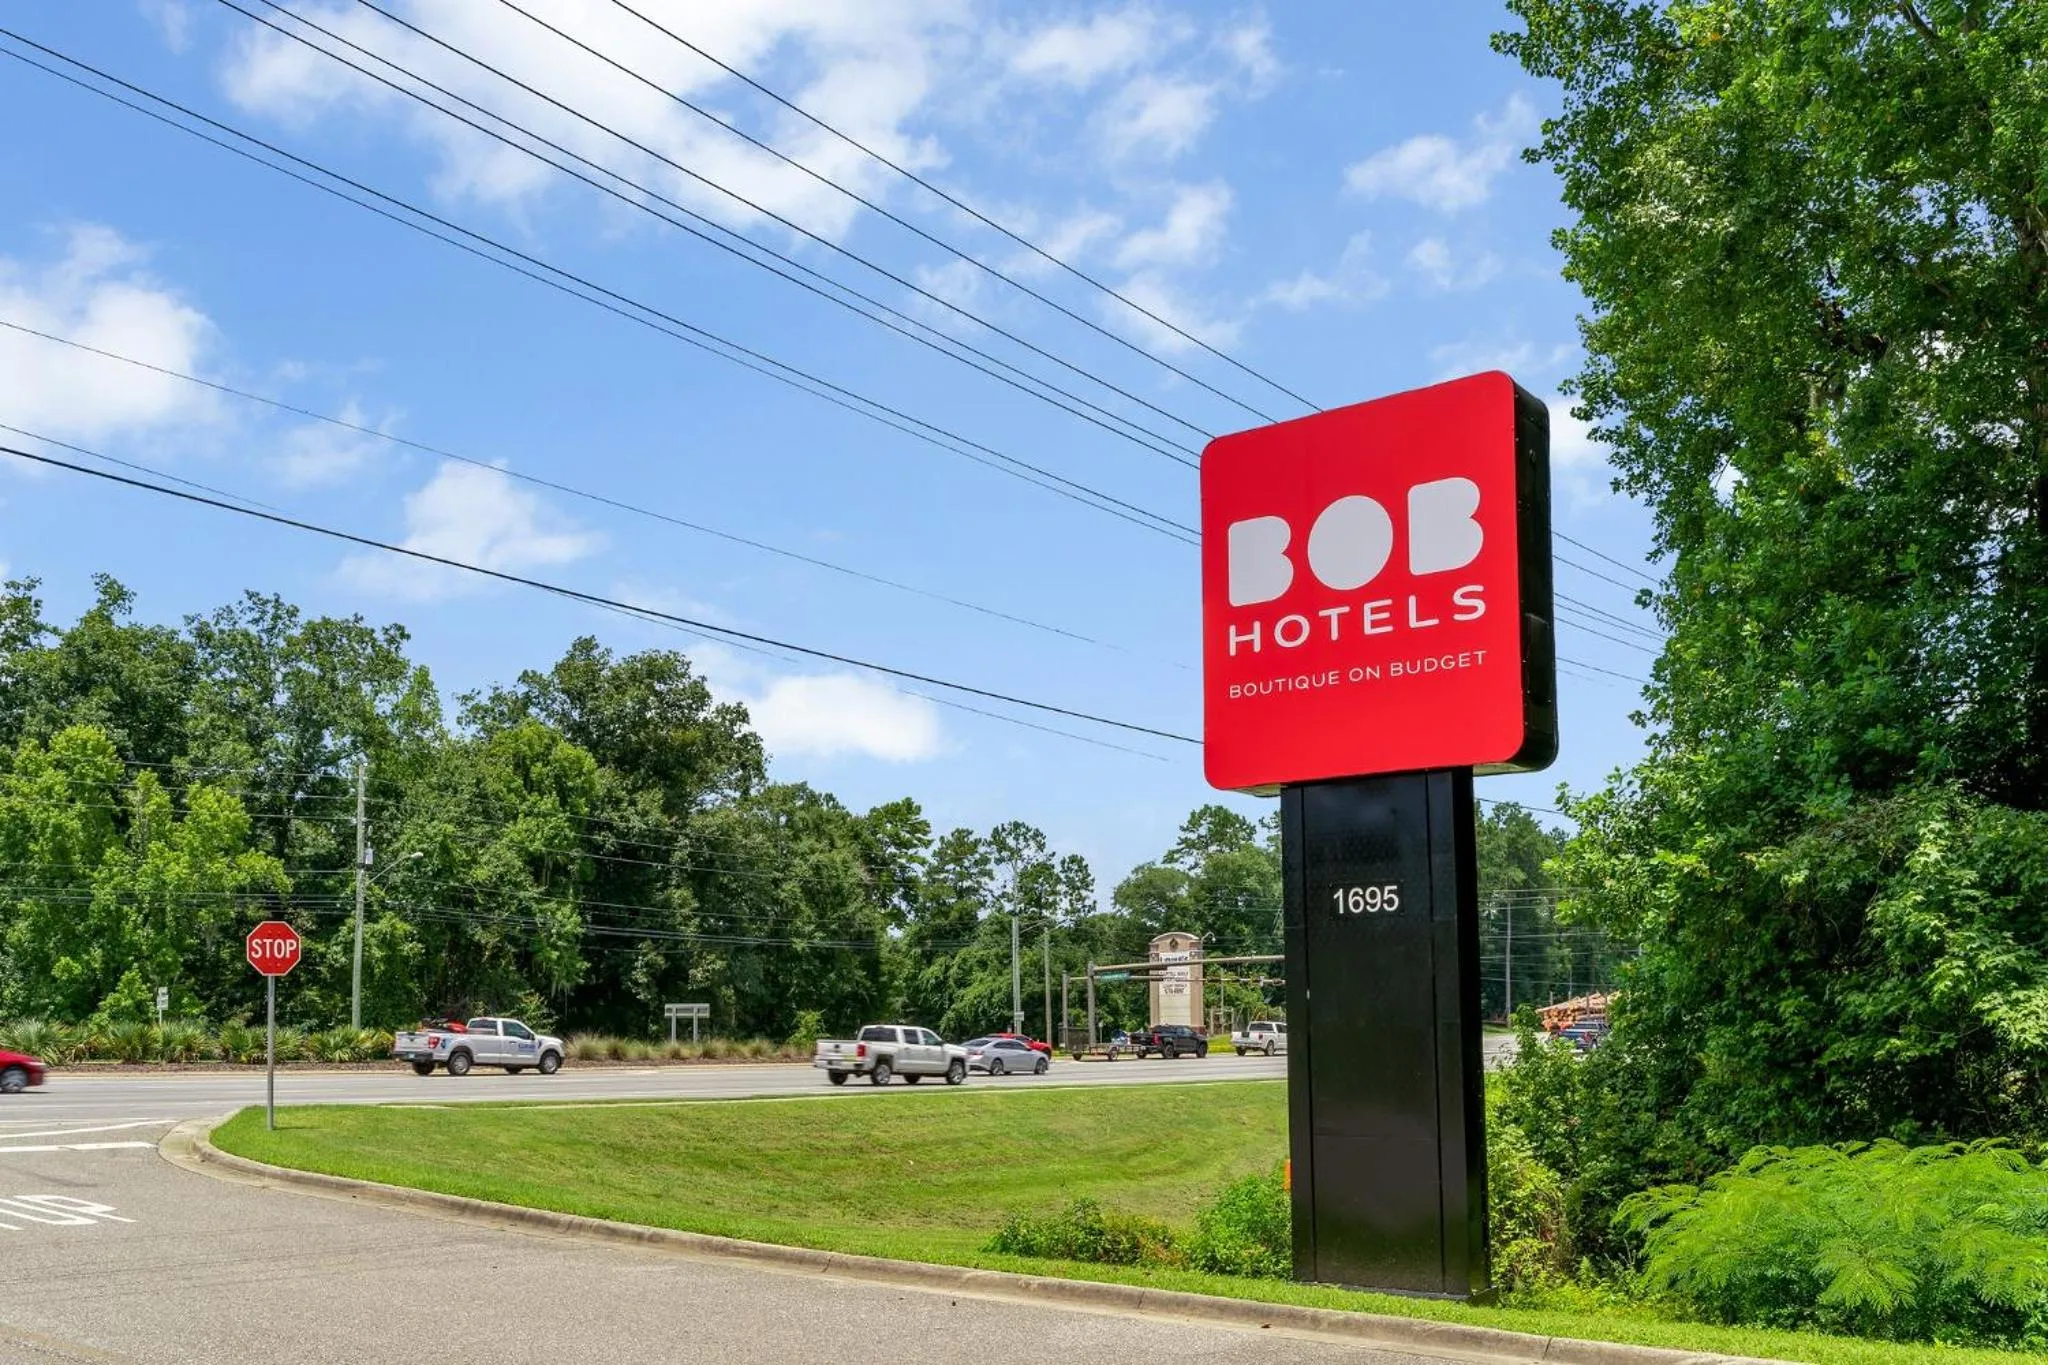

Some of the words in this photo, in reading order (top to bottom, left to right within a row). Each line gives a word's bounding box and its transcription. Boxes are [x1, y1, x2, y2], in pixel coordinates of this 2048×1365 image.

[1228, 477, 1484, 607] BOB
[1229, 584, 1487, 657] HOTELS
[1229, 670, 1340, 699] BOUTIQUE
[1348, 665, 1381, 682] ON
[1390, 650, 1487, 677] BUDGET
[1333, 885, 1400, 914] 1695
[251, 938, 298, 959] STOP
